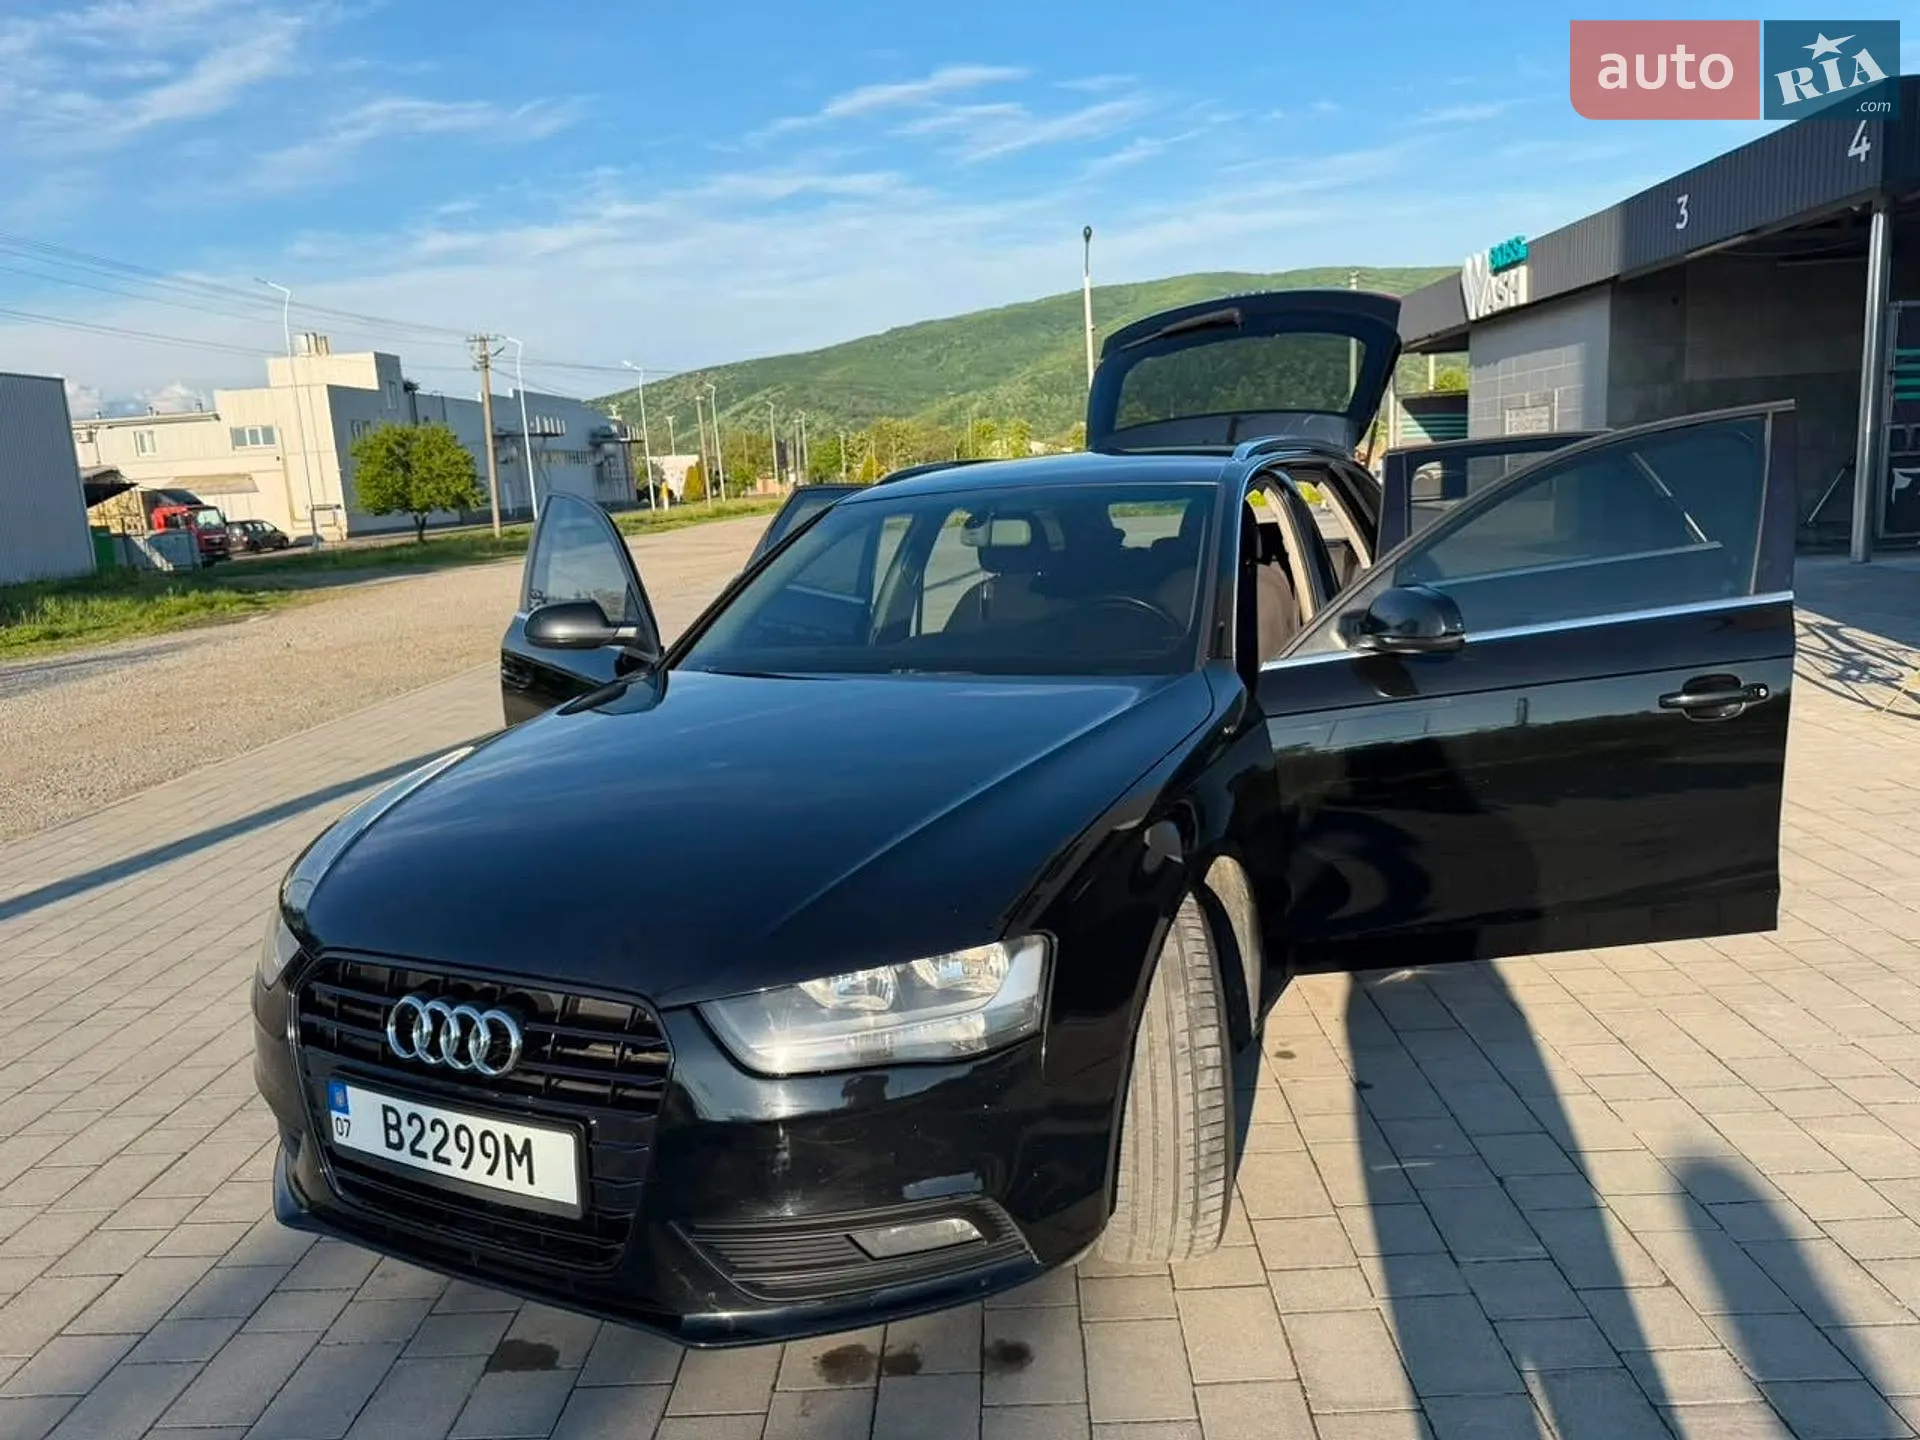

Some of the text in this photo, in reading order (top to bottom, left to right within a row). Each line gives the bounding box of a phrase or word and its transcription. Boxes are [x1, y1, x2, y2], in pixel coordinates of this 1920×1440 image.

[1847, 119, 1872, 163] 4
[1675, 194, 1691, 230] 3
[1462, 247, 1531, 321] WASH
[335, 1116, 351, 1139] 07
[382, 1104, 536, 1186] B2299M
